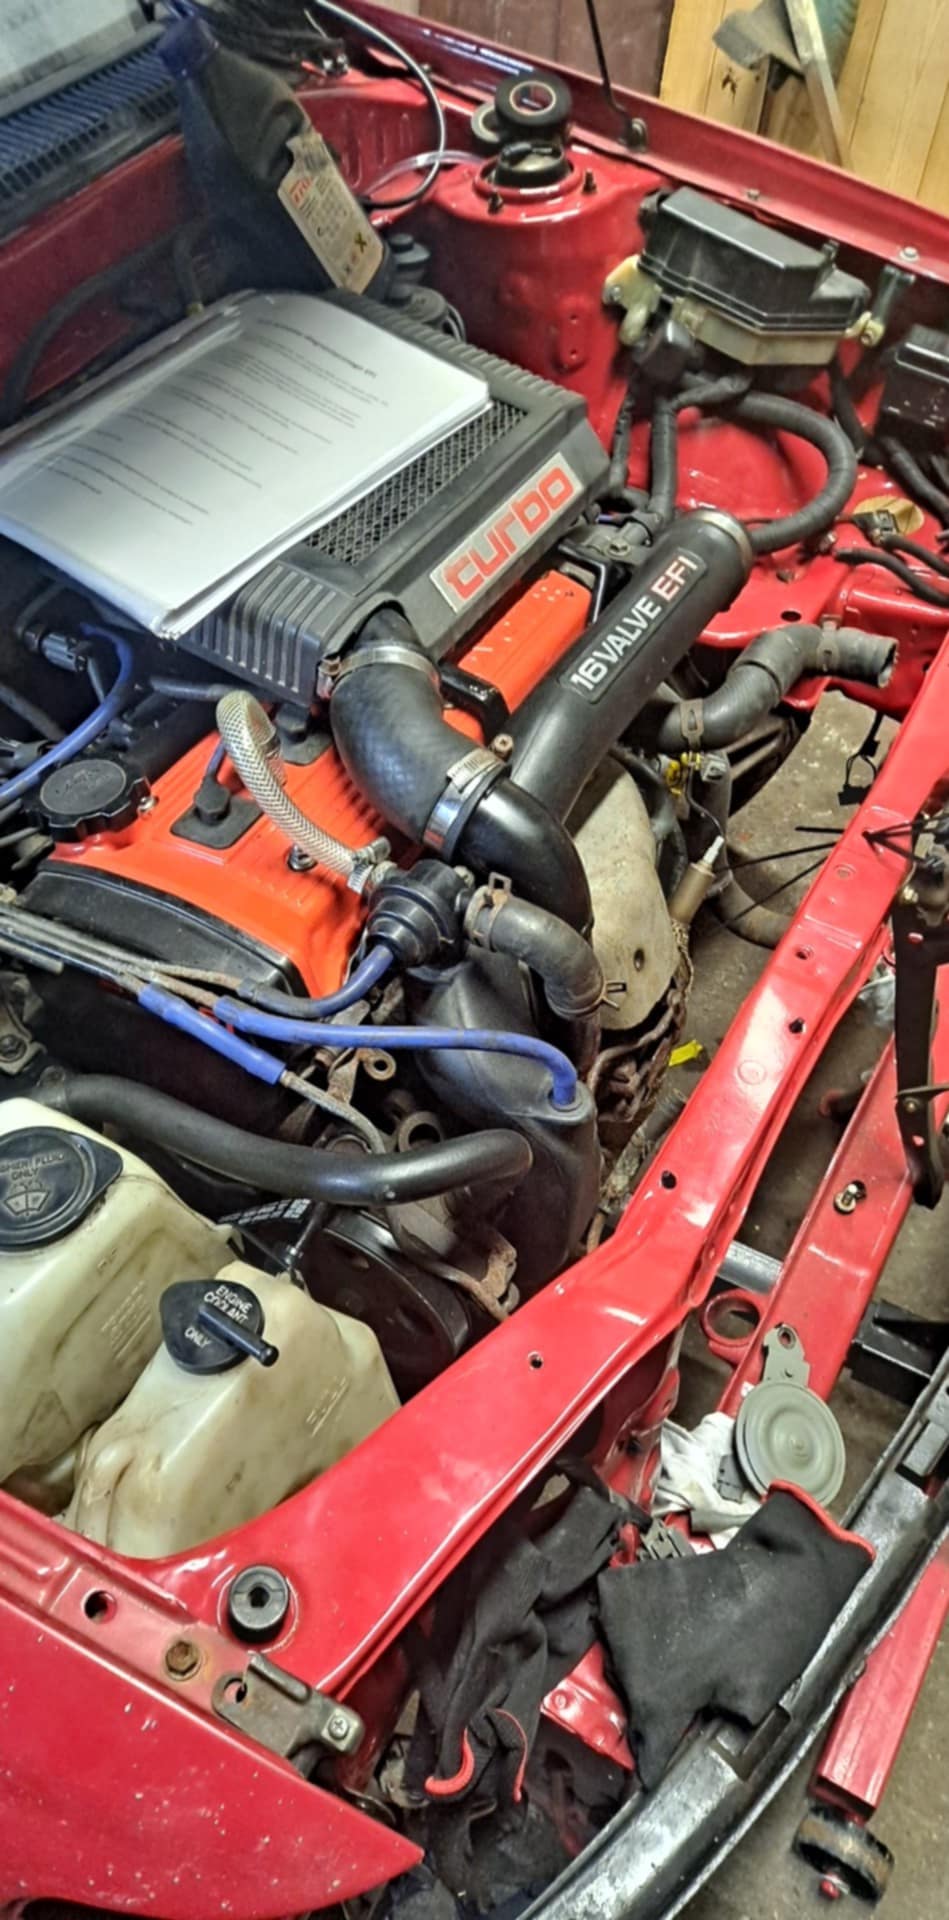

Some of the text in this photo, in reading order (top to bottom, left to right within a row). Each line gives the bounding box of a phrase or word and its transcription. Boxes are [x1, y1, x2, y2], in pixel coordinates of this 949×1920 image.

[443, 467, 574, 600] turbo
[651, 556, 698, 602] EFI
[203, 1291, 248, 1324] COOLANT
[216, 1284, 253, 1314] ENGINE
[184, 1326, 211, 1348] ONLY
